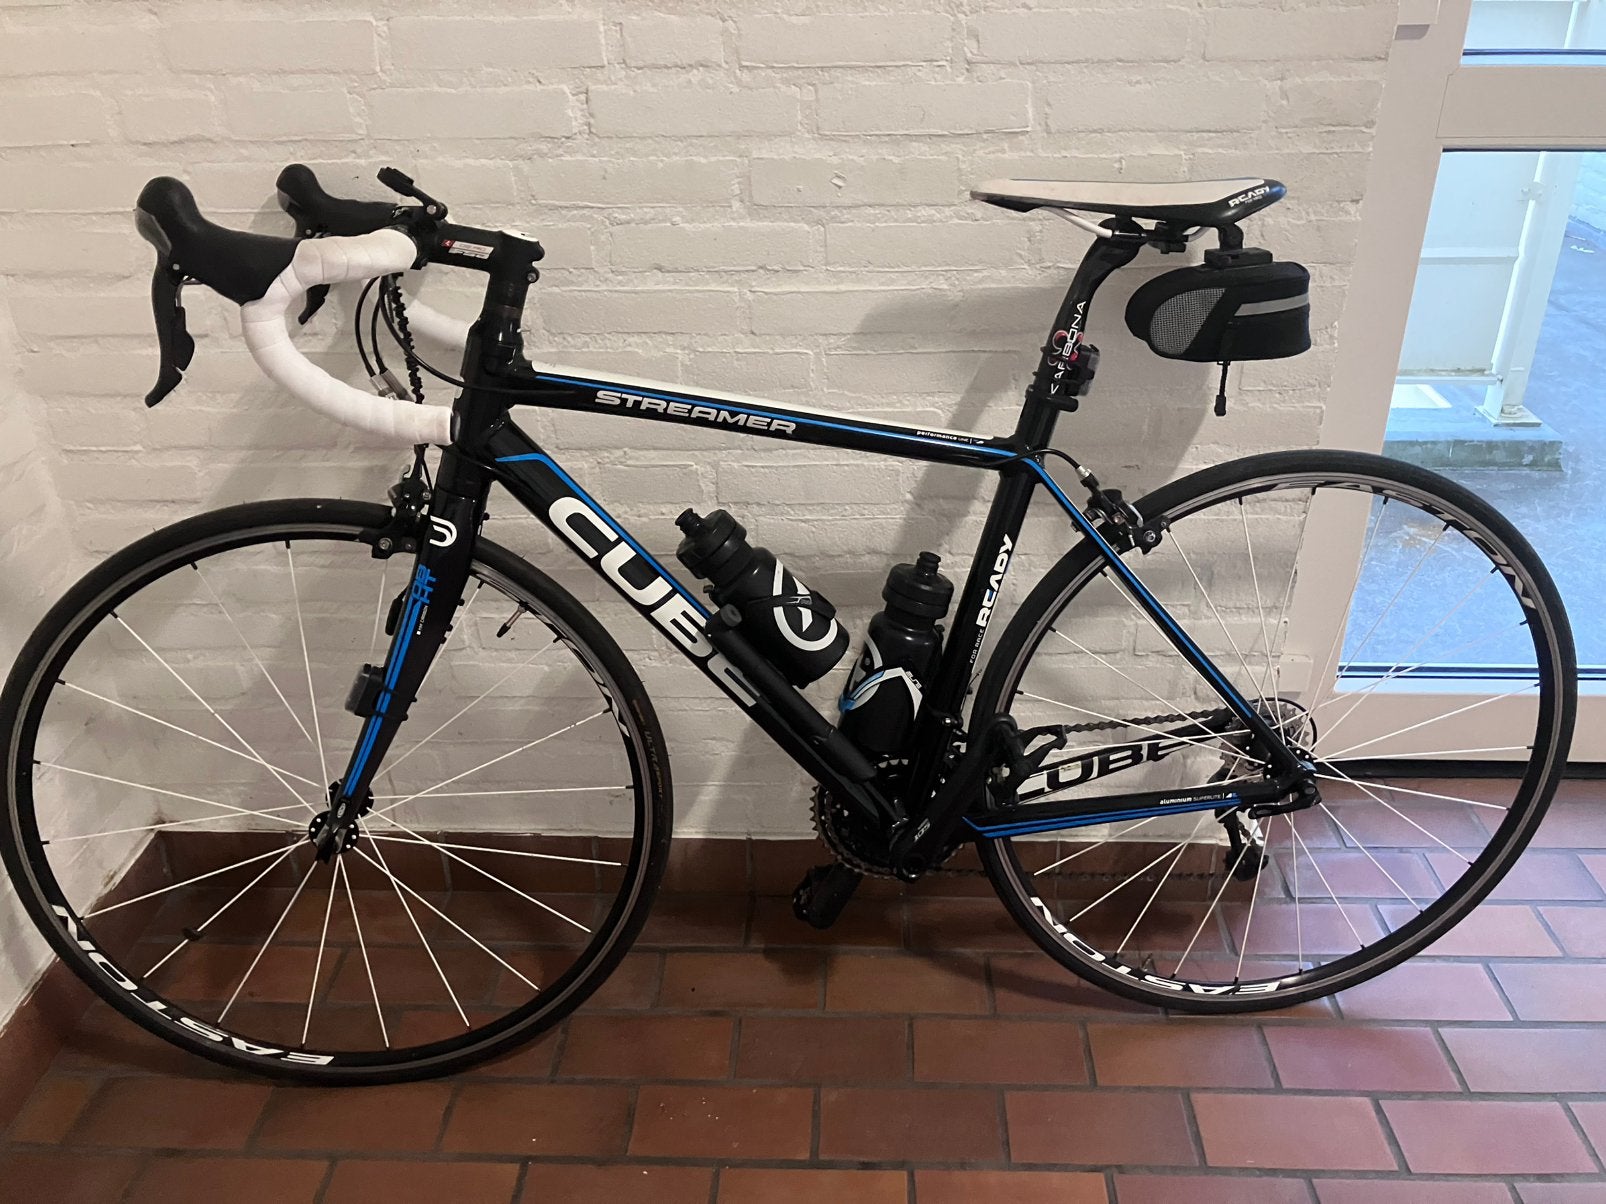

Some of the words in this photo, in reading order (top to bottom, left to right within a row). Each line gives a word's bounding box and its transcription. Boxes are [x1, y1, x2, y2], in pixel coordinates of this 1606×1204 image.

[595, 390, 796, 434] STREAMER
[916, 430, 957, 441] performance
[549, 496, 757, 707] CUBE
[1160, 797, 1192, 805] aluminium
[1030, 896, 1281, 996] EASTON
[51, 904, 335, 1066] EASTON
